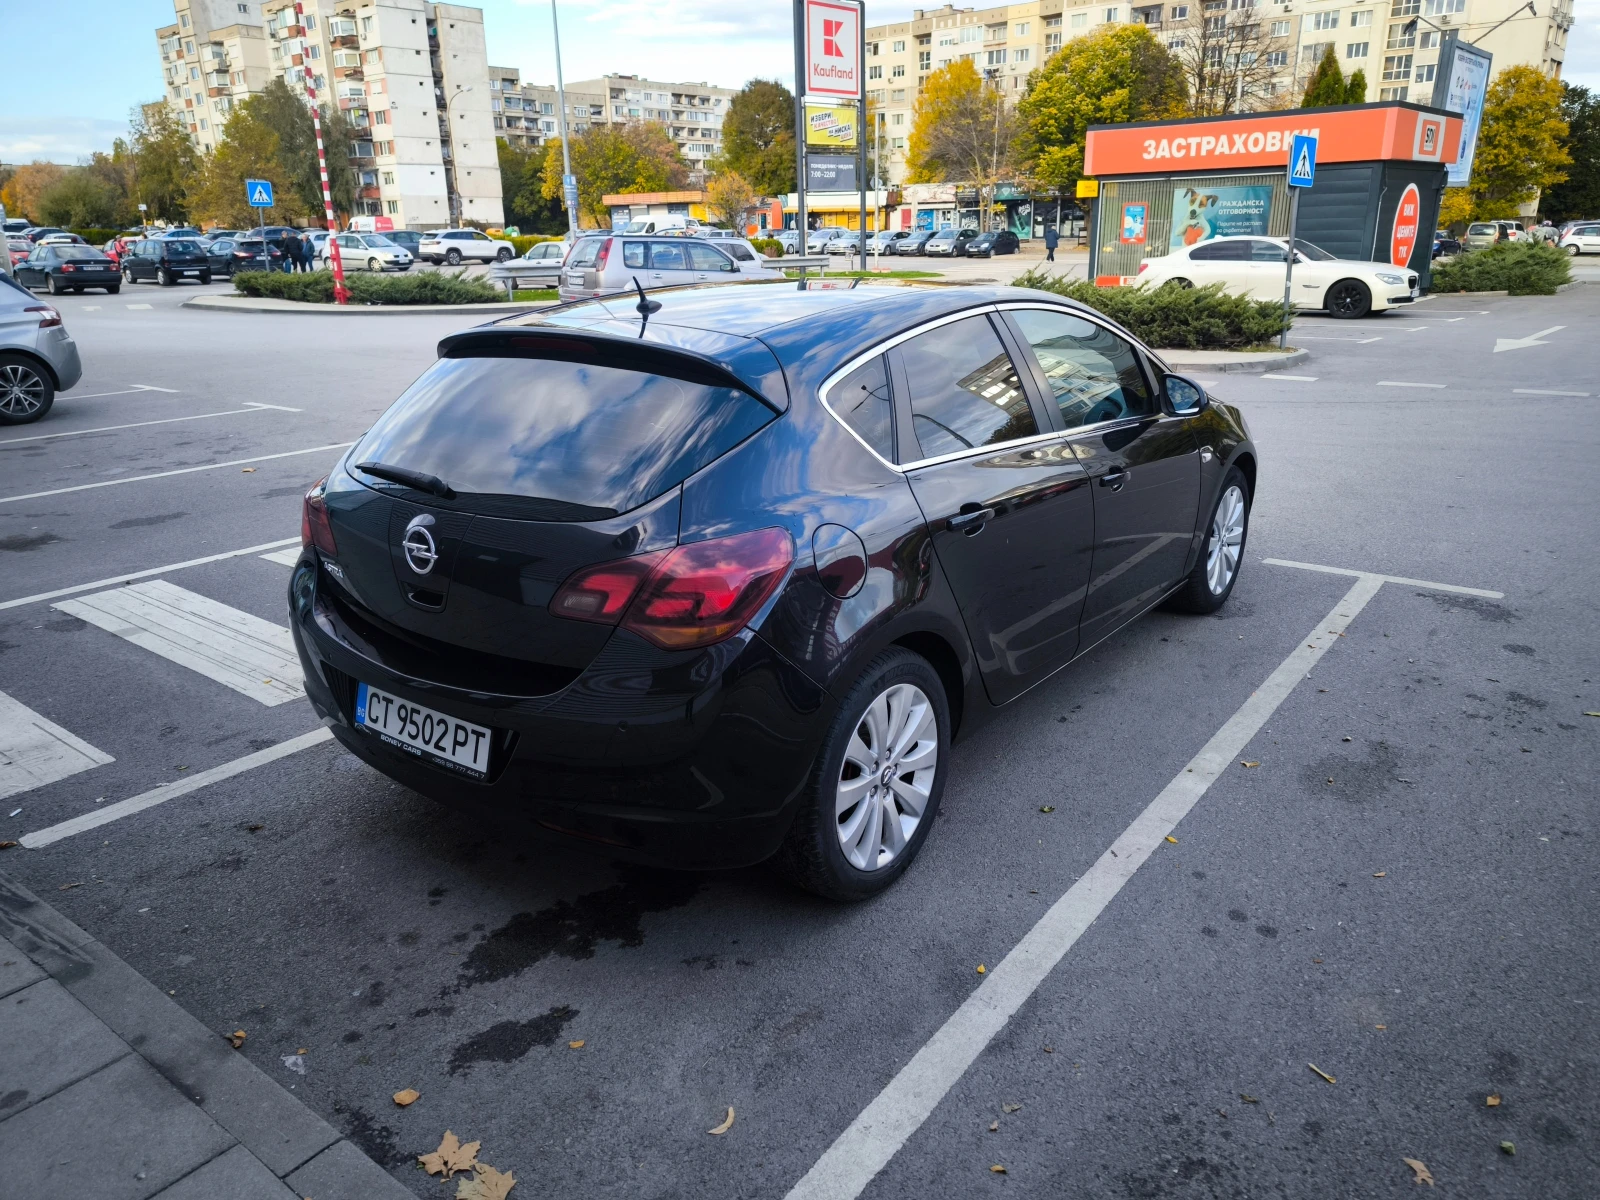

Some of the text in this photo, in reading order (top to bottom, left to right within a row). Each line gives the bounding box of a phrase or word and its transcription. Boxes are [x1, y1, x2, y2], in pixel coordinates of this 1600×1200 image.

[813, 63, 853, 80] Kaufland
[1219, 199, 1265, 207] ГРАЖДАНСКА
[1218, 207, 1264, 215] ОТГОВОРНОСТ
[357, 706, 365, 718] BG
[380, 733, 422, 756] BONEV CARS
